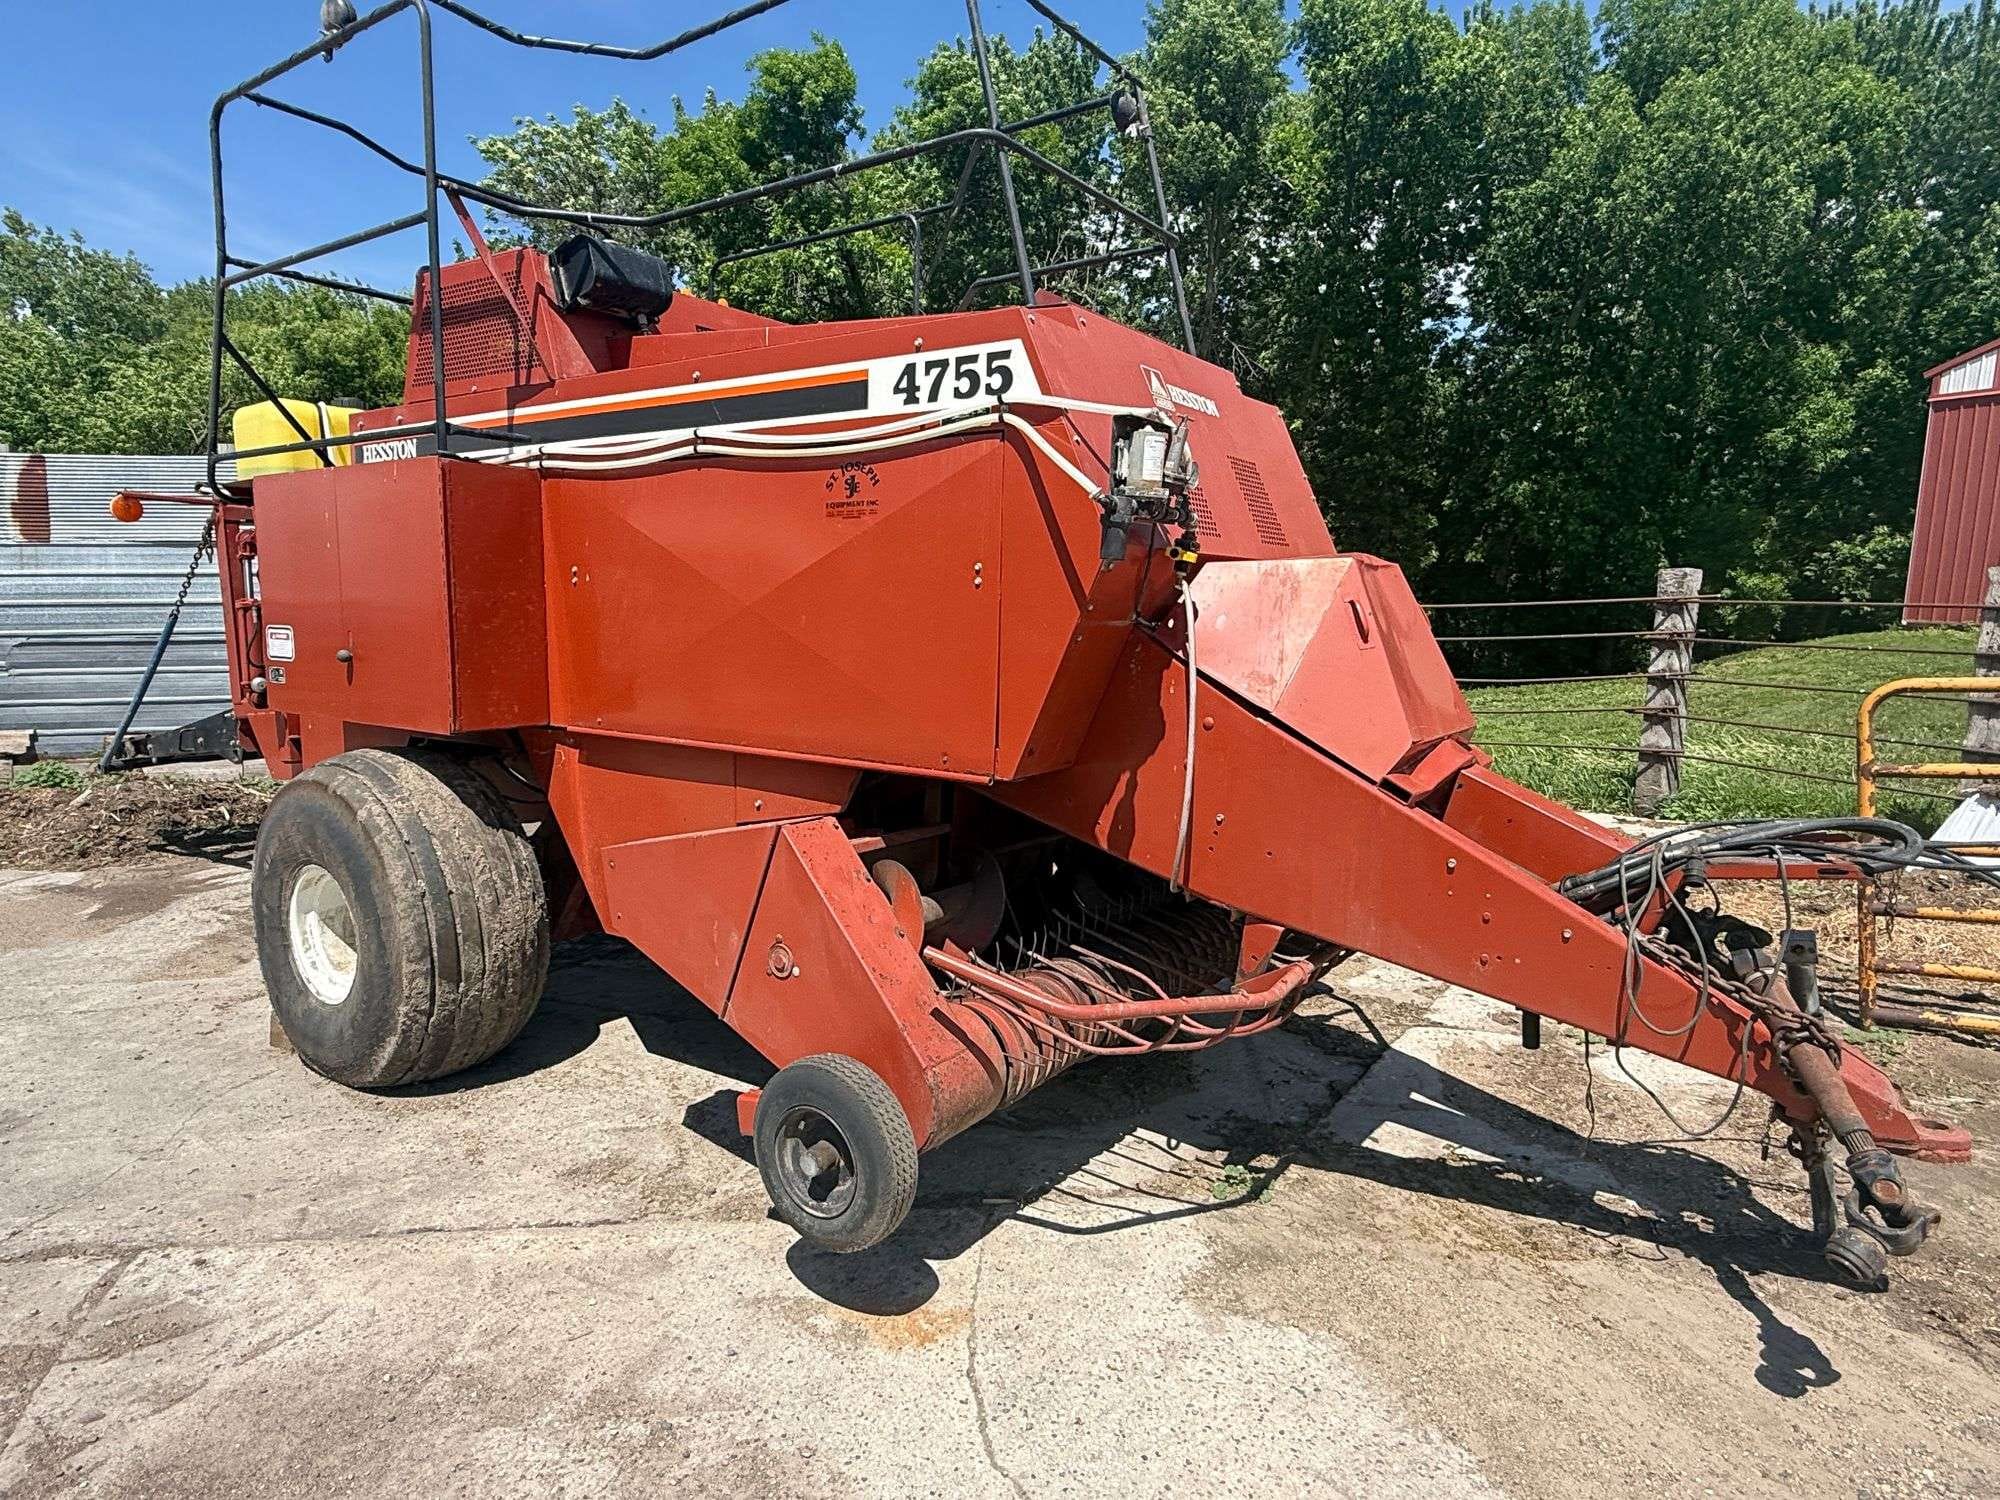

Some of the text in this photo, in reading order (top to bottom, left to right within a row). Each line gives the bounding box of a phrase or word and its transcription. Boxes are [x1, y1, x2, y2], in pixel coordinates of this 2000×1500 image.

[893, 349, 1014, 406] 4755
[1165, 383, 1220, 418] HESSTON
[362, 438, 417, 464] HESSTON
[840, 461, 881, 488] JOSEPH
[825, 500, 865, 509] EQUIPMENT
